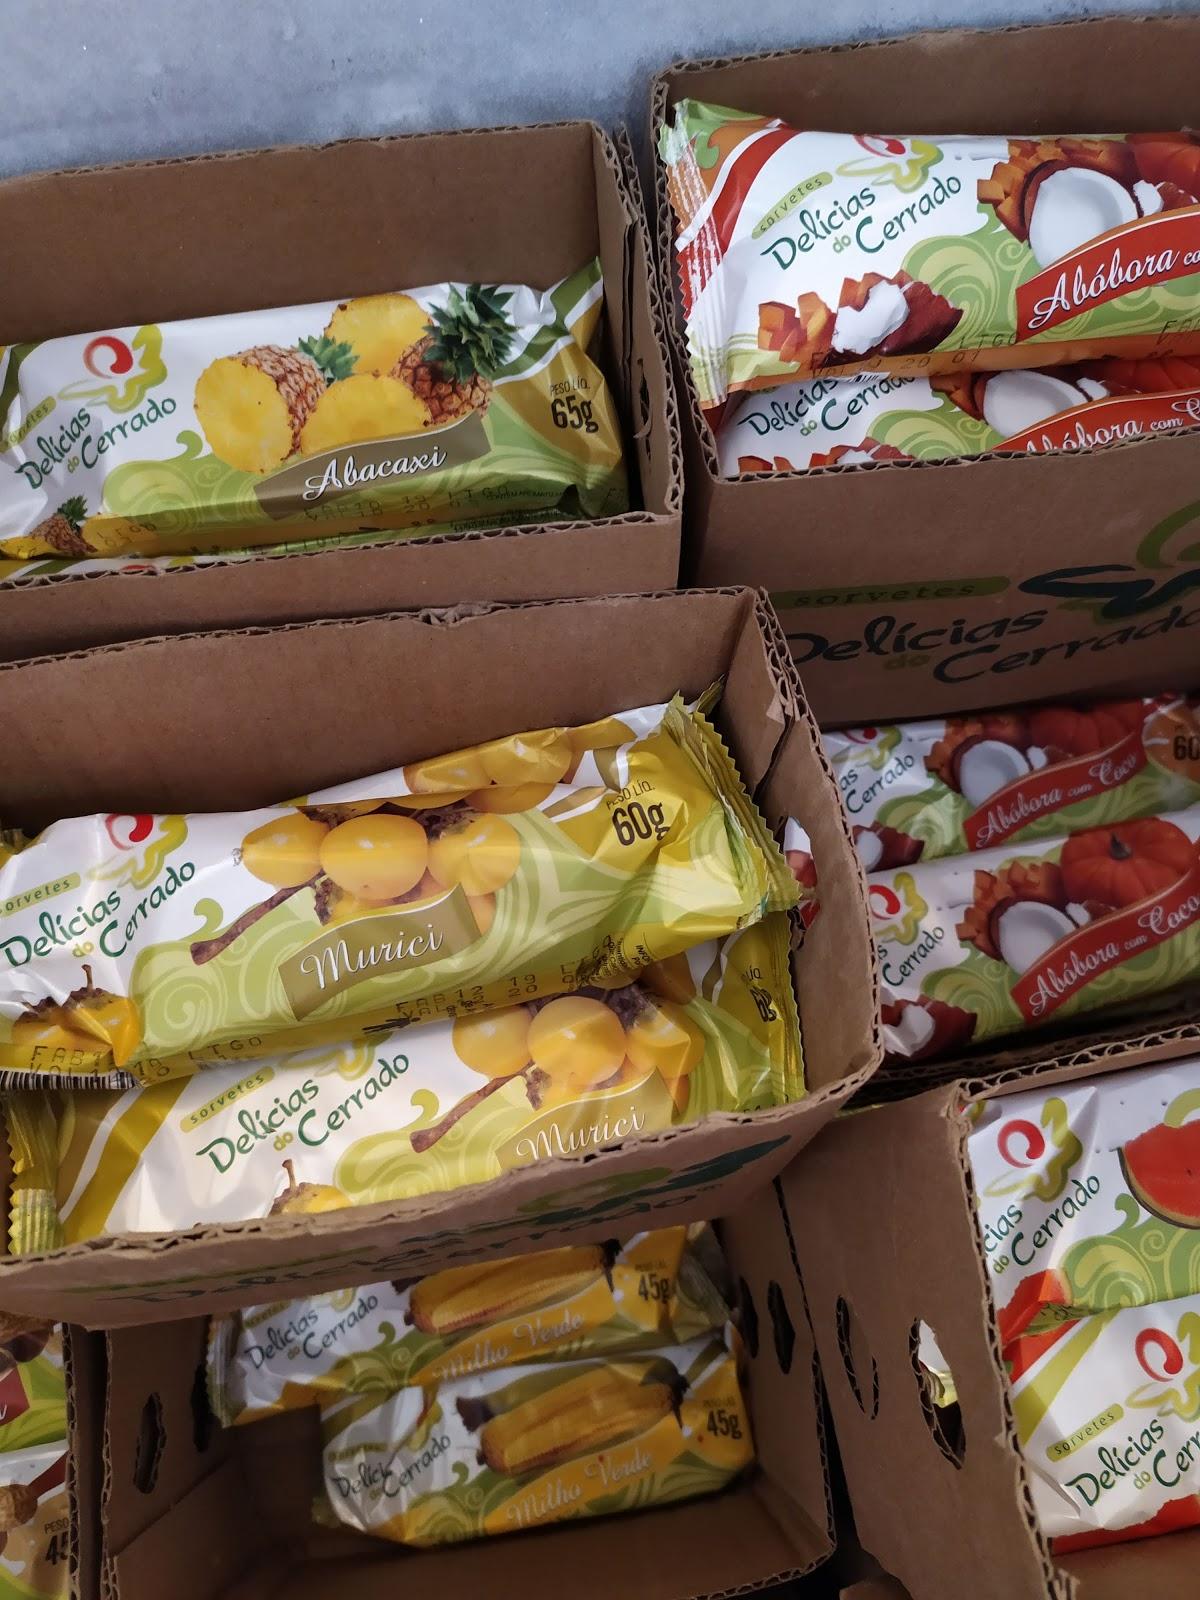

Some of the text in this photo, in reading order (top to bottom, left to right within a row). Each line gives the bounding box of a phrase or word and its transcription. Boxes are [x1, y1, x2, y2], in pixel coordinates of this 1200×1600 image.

[760, 176, 823, 233] sorvetes
[760, 186, 876, 270] Delícias
[832, 176, 962, 254] do Cerrado
[1028, 247, 1181, 330] Abóbora
[67, 397, 177, 475] do Cerrado
[551, 395, 600, 433] 65g
[800, 420, 818, 437] do
[1150, 416, 1183, 431] com
[15, 406, 91, 489] Delícias
[302, 445, 448, 501] Abacaxi
[795, 583, 976, 608] sorvetes
[932, 604, 1200, 684] Cerrado
[845, 754, 914, 814] Cerrado
[976, 787, 1064, 848] Abóbora
[1088, 751, 1139, 786] Coco
[611, 800, 671, 847] 60g
[0, 889, 121, 967] Delícias
[72, 861, 196, 959] do Cerrado
[300, 922, 444, 990] Murici
[882, 926, 945, 987] Cerrado
[1029, 939, 1120, 1017] Abóbora
[1137, 900, 1200, 936] Coco
[190, 1072, 265, 1126] sorvetes
[195, 1079, 319, 1174] Delícias
[273, 1053, 410, 1152] do Cerrado
[515, 1105, 647, 1161] Murici
[1011, 1174, 1101, 1266] Cerrado
[637, 1272, 670, 1305] 45g
[244, 1309, 319, 1370] Delícias
[302, 1294, 379, 1359] Cerrado
[707, 1408, 743, 1440] 45g
[1054, 1411, 1115, 1455] sorvetes
[381, 1434, 451, 1498] Cerrado
[1065, 1418, 1165, 1507] Delícias
[1133, 1469, 1151, 1490] do
